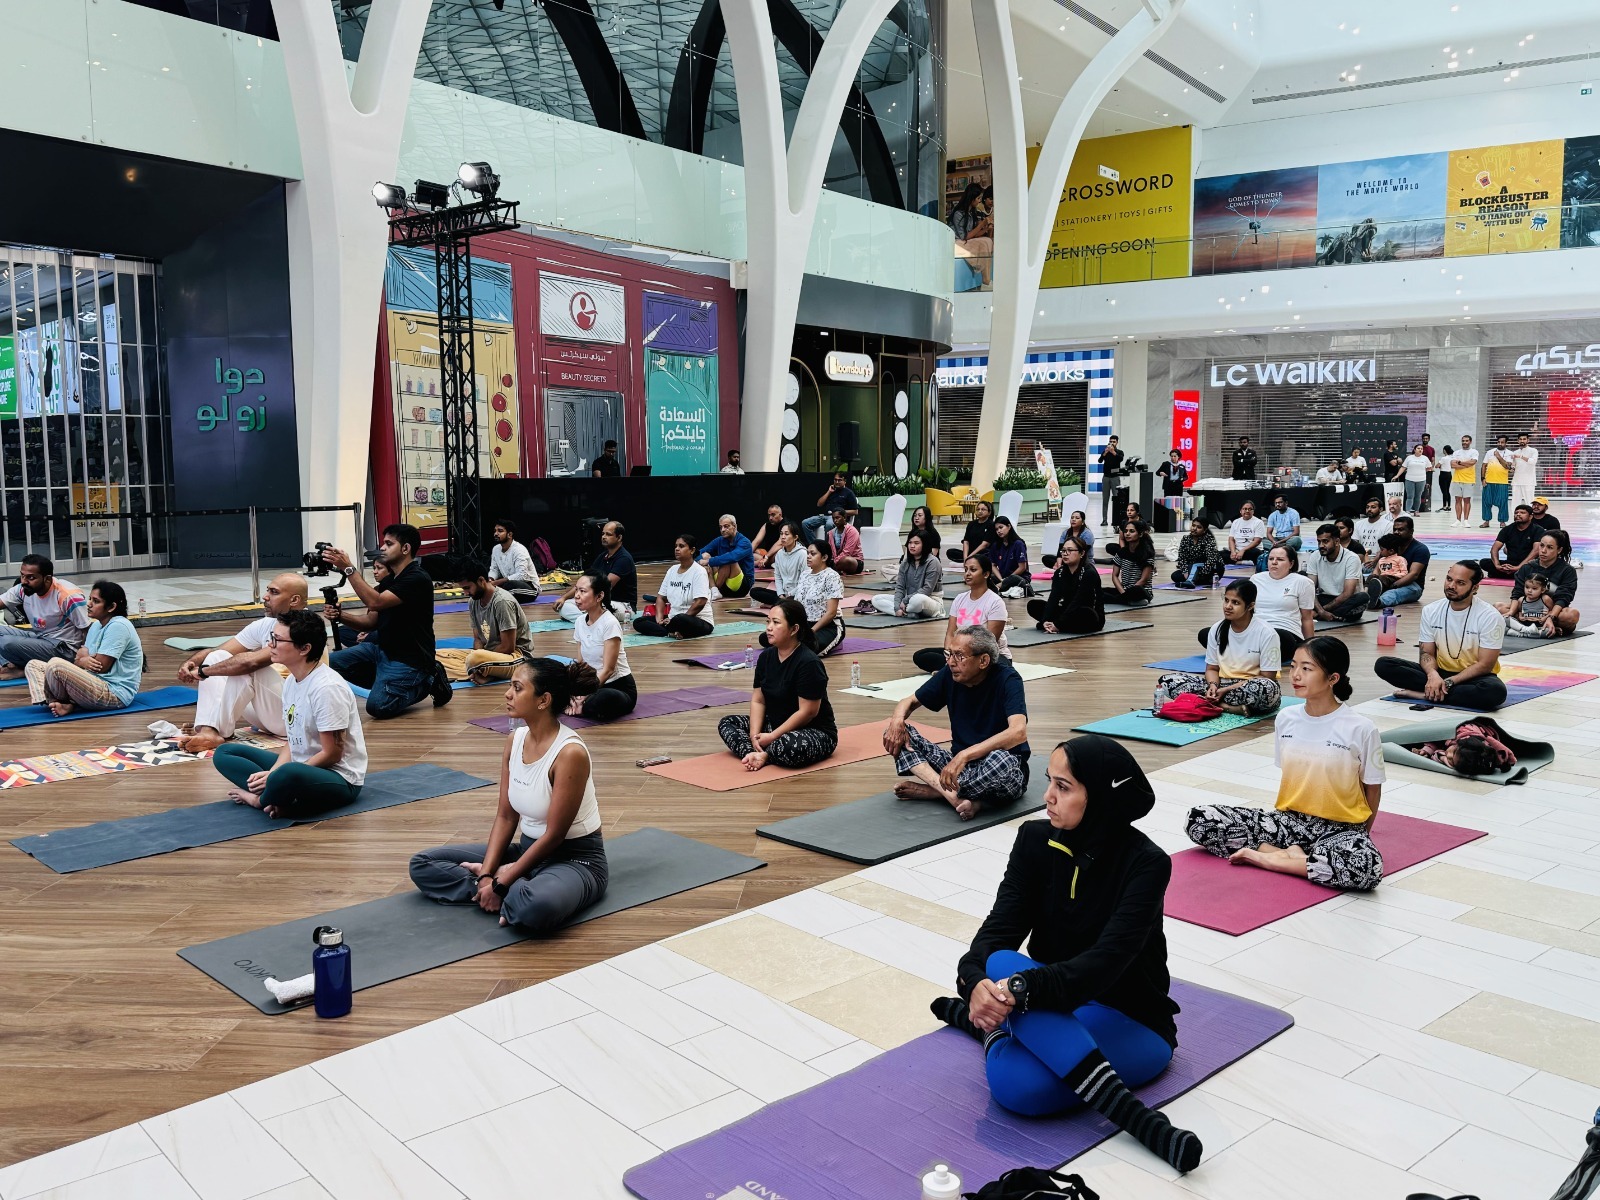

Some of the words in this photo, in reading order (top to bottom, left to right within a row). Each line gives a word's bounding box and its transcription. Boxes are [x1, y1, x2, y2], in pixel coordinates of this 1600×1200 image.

[1356, 178, 1393, 189] WELCOME
[1398, 177, 1407, 185] TO
[1253, 191, 1283, 200] THUNDER
[1346, 188, 1360, 197] THE
[1363, 186, 1388, 195] MOVIE
[1392, 182, 1419, 192] WORLD
[1499, 186, 1509, 195] A
[1229, 200, 1250, 208] COMES
[1459, 191, 1549, 208] BLOCKBUSTER
[1477, 202, 1529, 214] REASON
[1061, 212, 1112, 227] STATIONERY
[1119, 209, 1141, 219] TOYS
[1147, 205, 1173, 215] GIFTS
[1474, 214, 1486, 222] TO
[1488, 212, 1513, 221] HANG
[1514, 210, 1532, 219] OUT
[1483, 220, 1507, 228] WITH
[1045, 243, 1107, 262] OPENING
[1110, 237, 1155, 254] SOON
[561, 372, 583, 381] BEAUTY
[583, 374, 607, 383] SECRETS
[966, 370, 980, 385] &
[1028, 364, 1085, 383] Works
[1210, 364, 1249, 388] LC
[660, 406, 706, 423] السعادة
[660, 424, 706, 443] جايتكم!
[1180, 438, 1193, 450] 19
[76, 502, 115, 510] SPECIA
